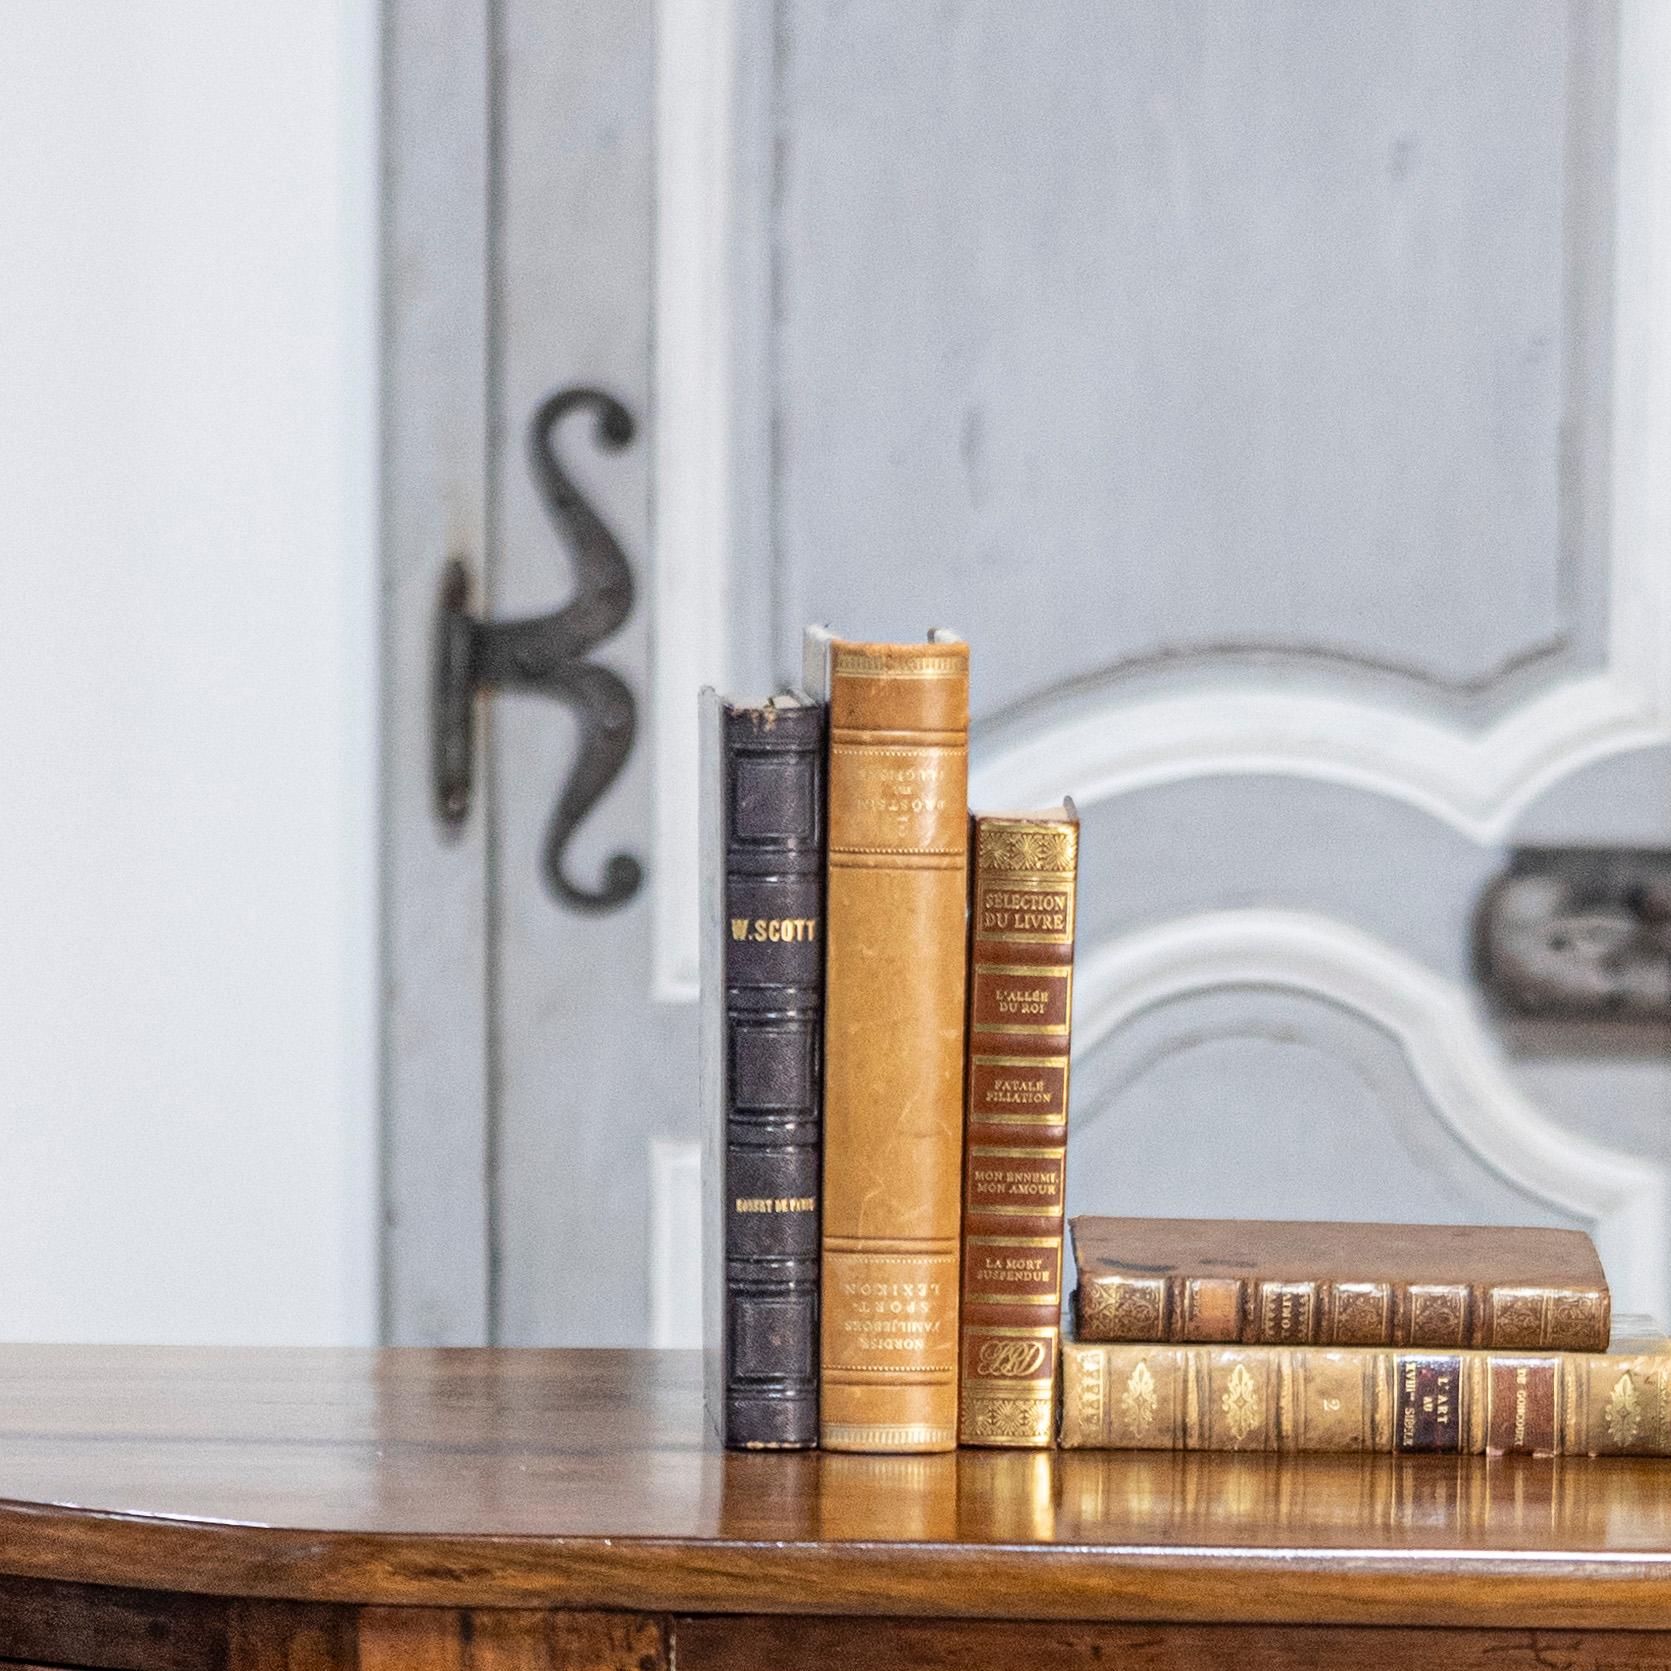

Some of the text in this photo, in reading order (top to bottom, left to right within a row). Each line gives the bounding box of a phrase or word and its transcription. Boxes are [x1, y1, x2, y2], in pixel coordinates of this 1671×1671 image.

[986, 892, 1066, 911] SÉLECTION
[985, 912, 1065, 930] DU LIVRE
[1000, 1002, 1045, 1015] DU ROI
[994, 1080, 1045, 1092] FATALE
[985, 1091, 1053, 1103] FILIATION
[975, 1170, 1003, 1182] MON
[977, 1183, 1057, 1195] MON AMOUR
[985, 1258, 1043, 1270] LA MORT
[976, 1270, 1051, 1282] SUSPENDUE
[844, 1283, 941, 1297] LEXIKON
[1516, 1367, 1528, 1385] DE
[1323, 1399, 1340, 1411] 2
[1422, 1396, 1433, 1412] AU
